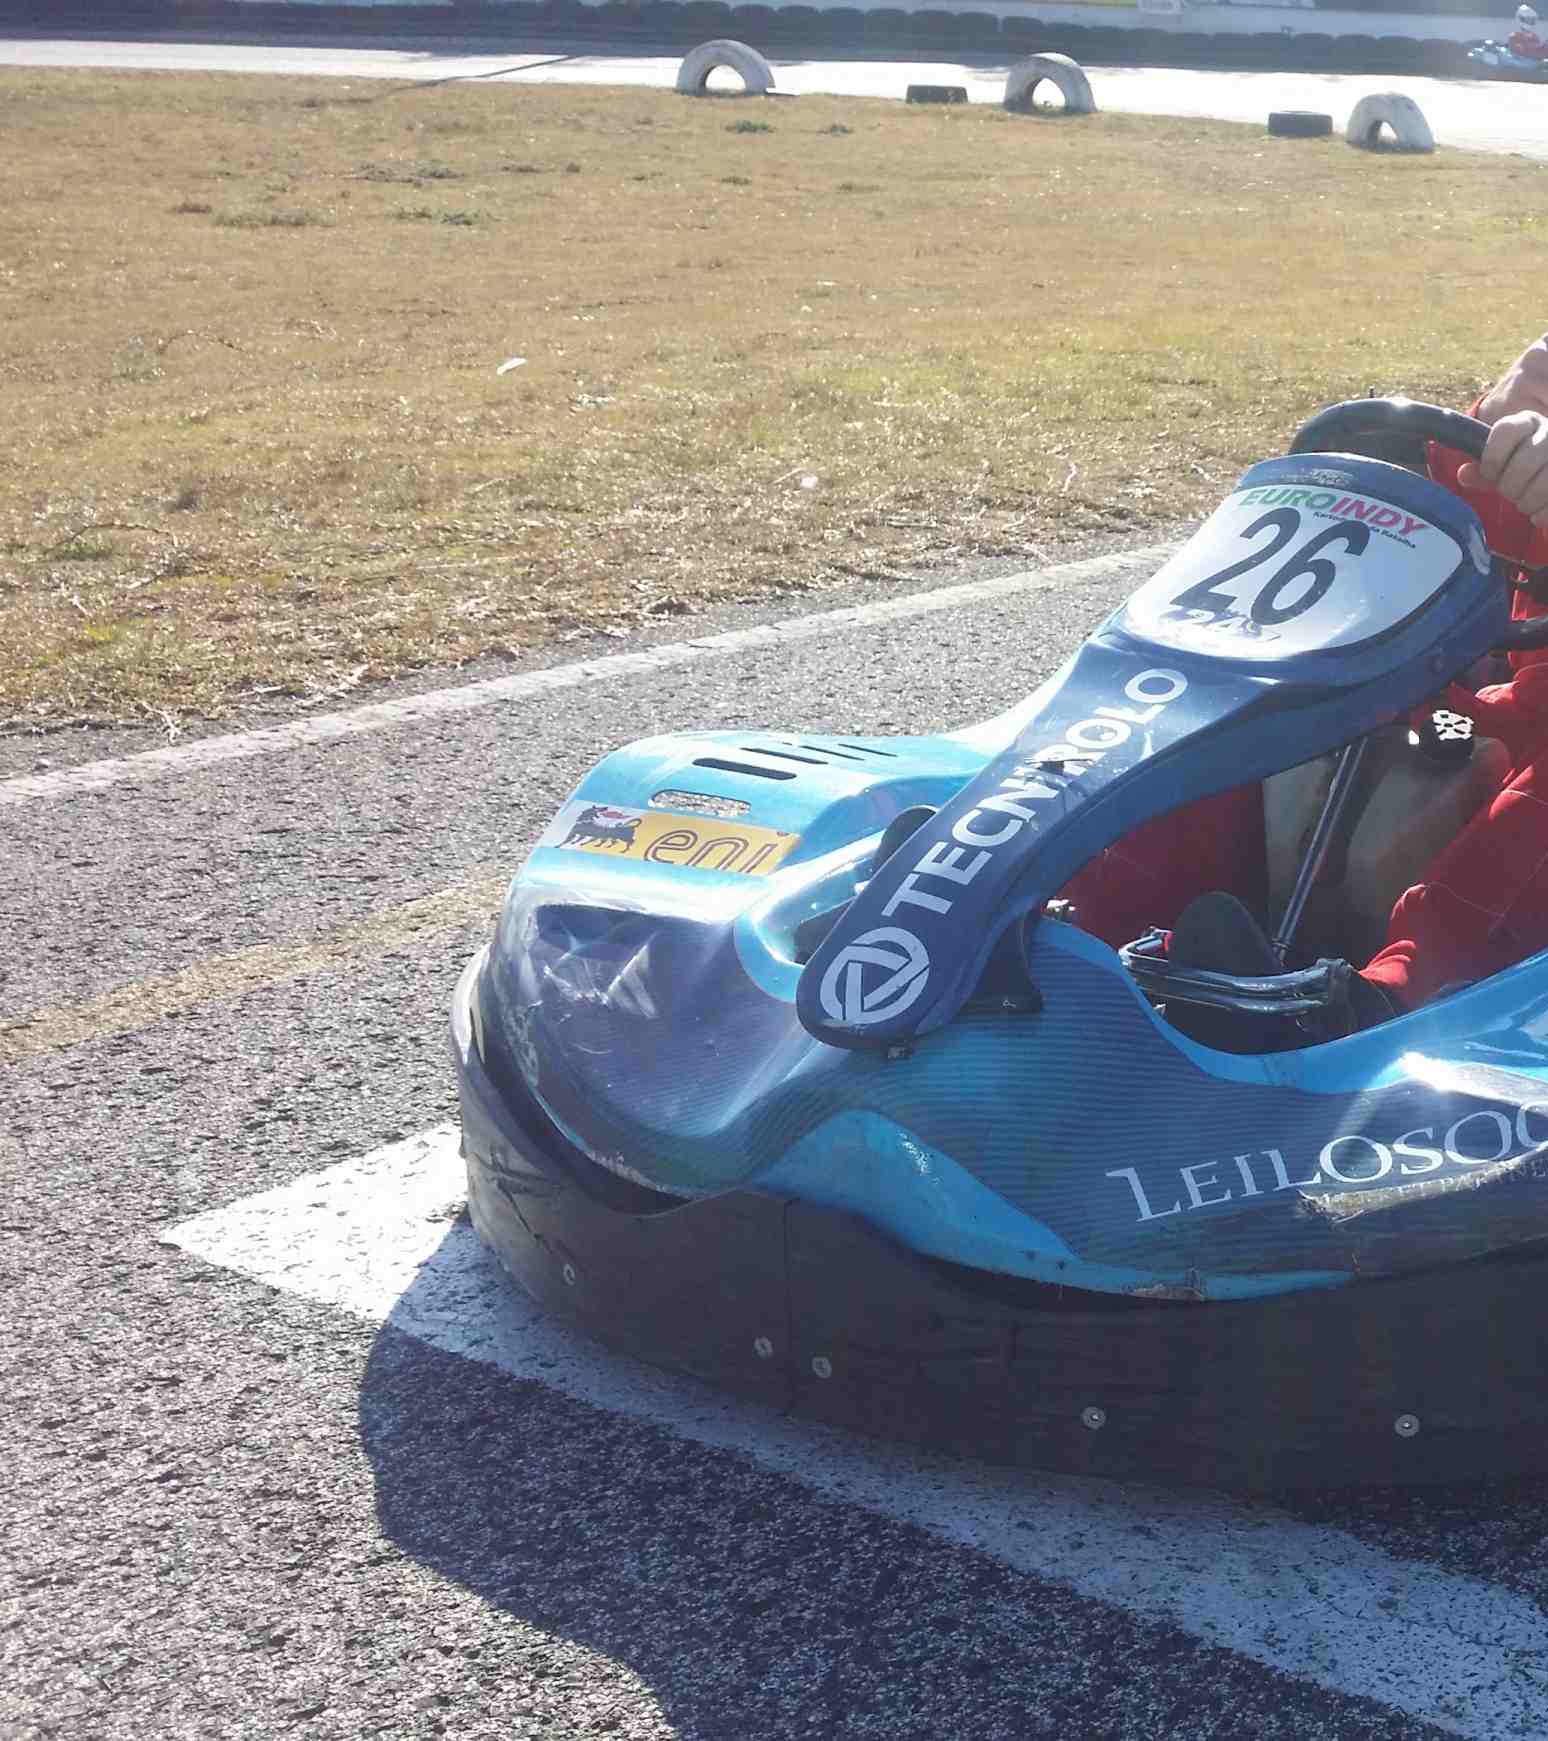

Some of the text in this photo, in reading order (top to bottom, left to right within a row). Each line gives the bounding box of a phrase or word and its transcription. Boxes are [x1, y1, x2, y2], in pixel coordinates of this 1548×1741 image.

[1239, 486, 1427, 537] EUROINDY
[1170, 507, 1371, 626] 26
[643, 828, 792, 874] eni
